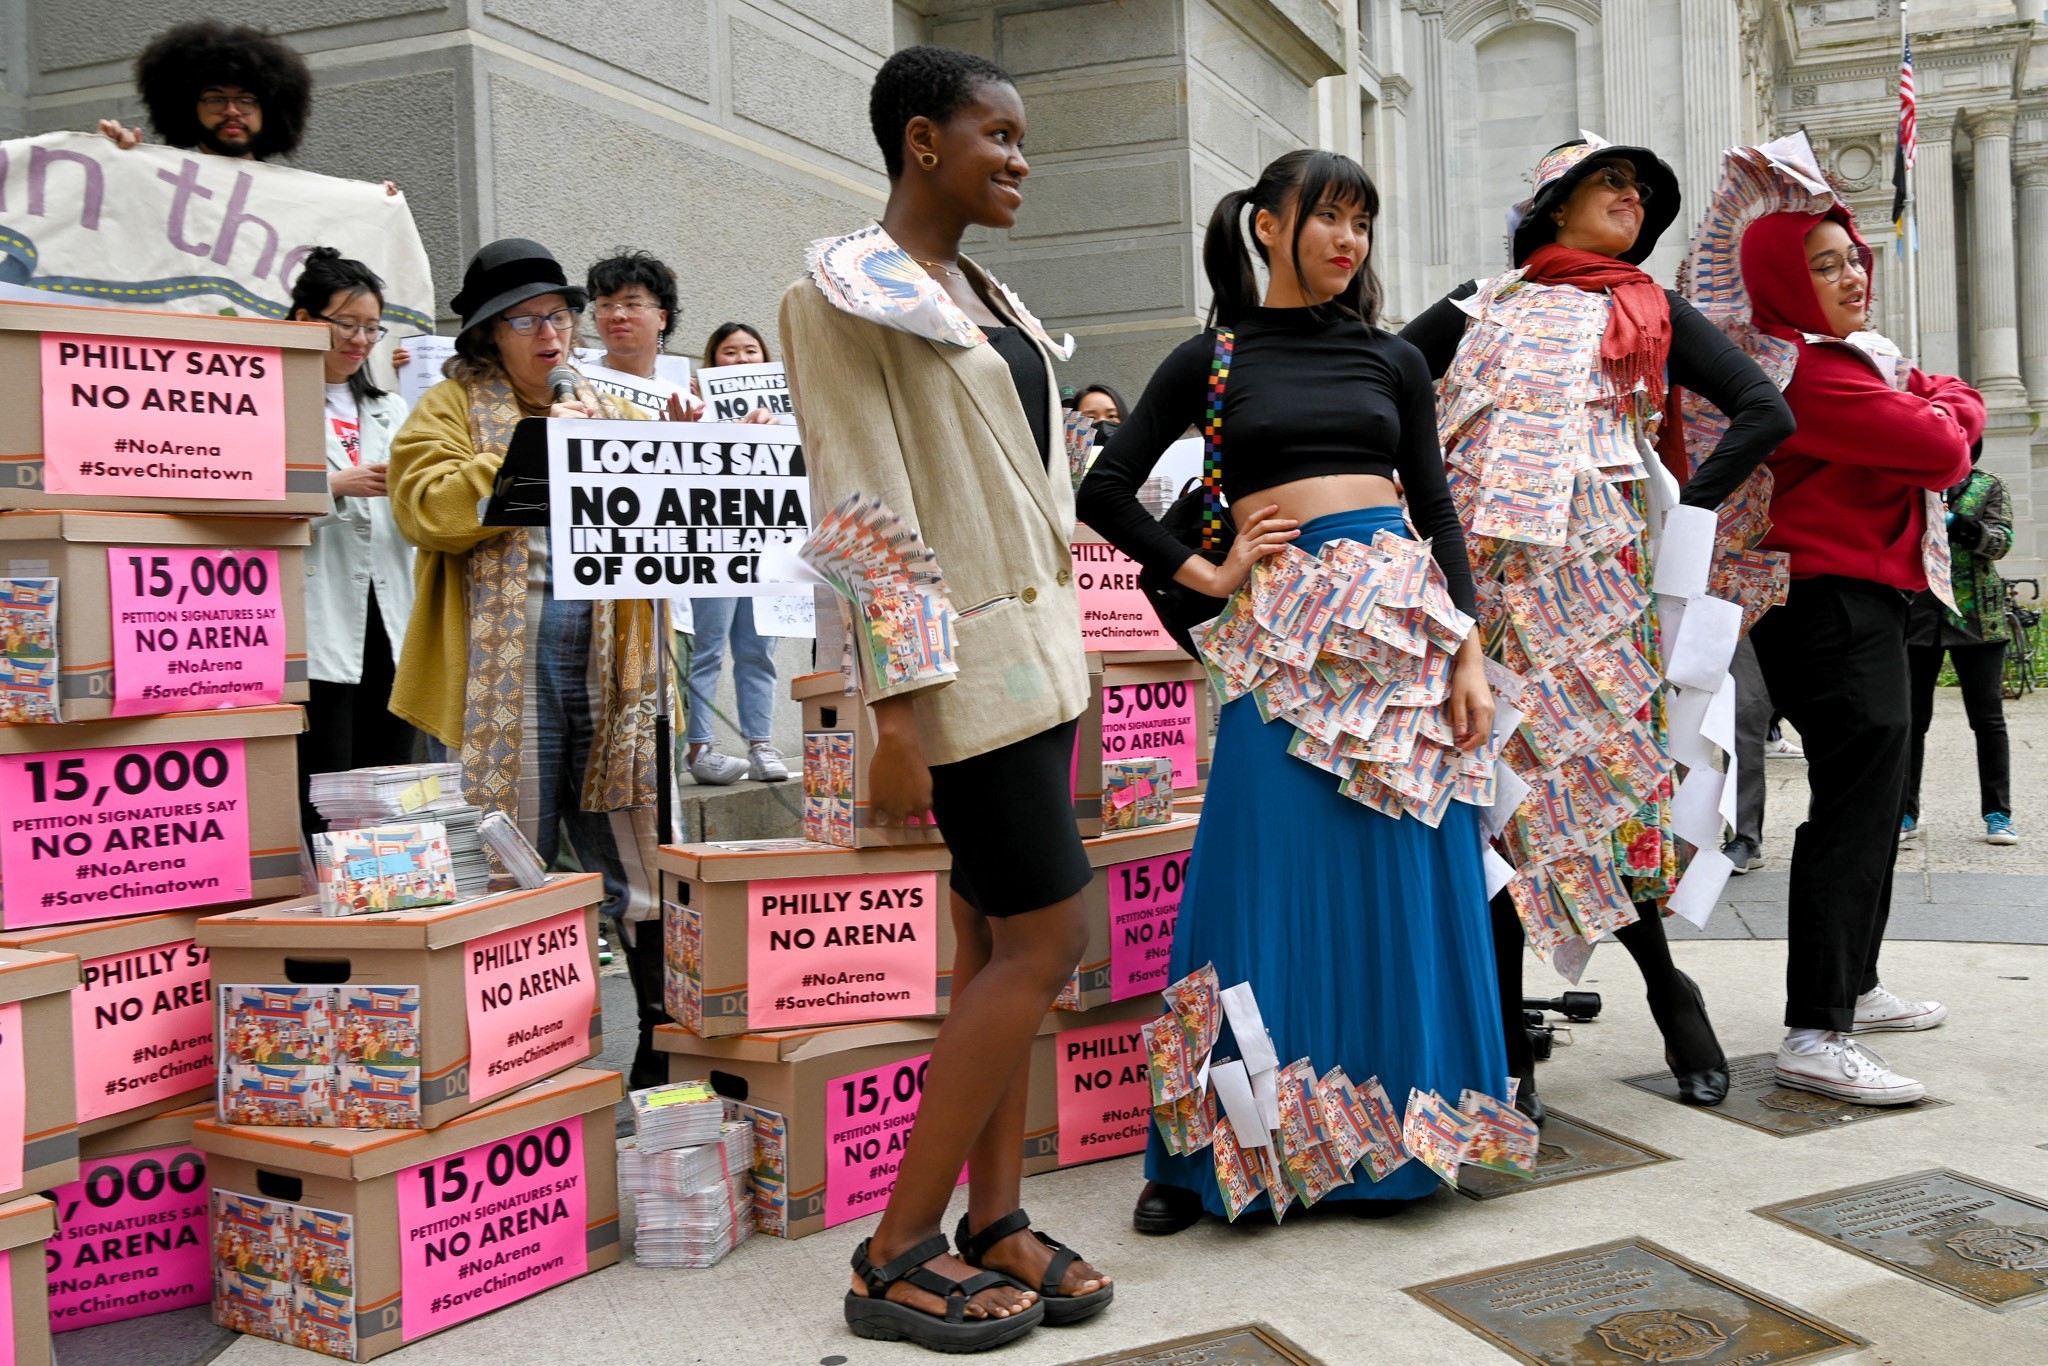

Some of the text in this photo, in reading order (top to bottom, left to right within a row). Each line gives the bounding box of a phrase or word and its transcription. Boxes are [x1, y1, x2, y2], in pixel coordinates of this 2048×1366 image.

[59, 342, 266, 379] PHILLY SAYS
[595, 380, 634, 400] NTS
[710, 374, 786, 395] TENANTS
[71, 384, 259, 417] NO ARENA
[714, 397, 748, 420] NO
[114, 439, 221, 457] #NoArena
[580, 439, 797, 476] LOCALS SAY
[79, 462, 253, 482] #SaveChinatown
[571, 486, 808, 527] NO ARENA
[573, 528, 612, 553] IN
[618, 528, 689, 553] THE
[1071, 545, 1117, 562] HILLY
[129, 556, 268, 604] 15,000
[574, 555, 760, 586] OF OUR CI
[122, 608, 276, 624] PETITION SIGNATURES SAY
[1084, 610, 1143, 621] #NoArena
[136, 625, 269, 652] NO ARENA
[1082, 627, 1159, 637] aveChinatown
[167, 659, 243, 675] #NoArena
[142, 680, 264, 700] #SaveChinatown
[1127, 718, 1176, 731] SIGNATURES
[1177, 717, 1191, 726] SAY
[1130, 730, 1185, 751] ARENA
[24, 747, 229, 807] 15,000
[12, 800, 237, 832] PETITION SIGNATURES SAY
[32, 818, 225, 860] NO ARENA
[75, 857, 186, 880] #NoArena
[41, 876, 220, 908] #SaveChinatown
[762, 887, 924, 916] PHILLY SAYS
[1115, 910, 1154, 925] PETITION
[473, 924, 578, 975] PHILLY SAYS
[770, 922, 916, 951] NO ARENA
[1125, 923, 1154, 947] NO
[84, 947, 178, 992] PHILLY
[801, 971, 885, 987] #NoArena
[481, 963, 581, 1012] NO ARENA
[775, 988, 910, 1010] #SaveChinatown
[96, 997, 143, 1030] NO
[507, 1019, 563, 1048] #NoArena
[1067, 1033, 1141, 1062] PHILLY
[487, 1035, 575, 1077] #SaveChinatown
[1075, 1070, 1112, 1093] NO
[833, 1112, 916, 1144] PETITION SIGNA
[418, 1126, 571, 1209] 15,000
[844, 1139, 881, 1167] NO
[410, 1175, 578, 1242] PETITION SIGNATURES SAY
[68, 1209, 177, 1239] SIGNATURES
[425, 1198, 570, 1268] NO ARENA
[73, 1224, 201, 1269] ARENA
[457, 1240, 541, 1280] #NoArena
[48, 1266, 159, 1297] #NoArena
[430, 1255, 564, 1314] #SaveChinatown
[49, 1283, 194, 1321] veChinatown
